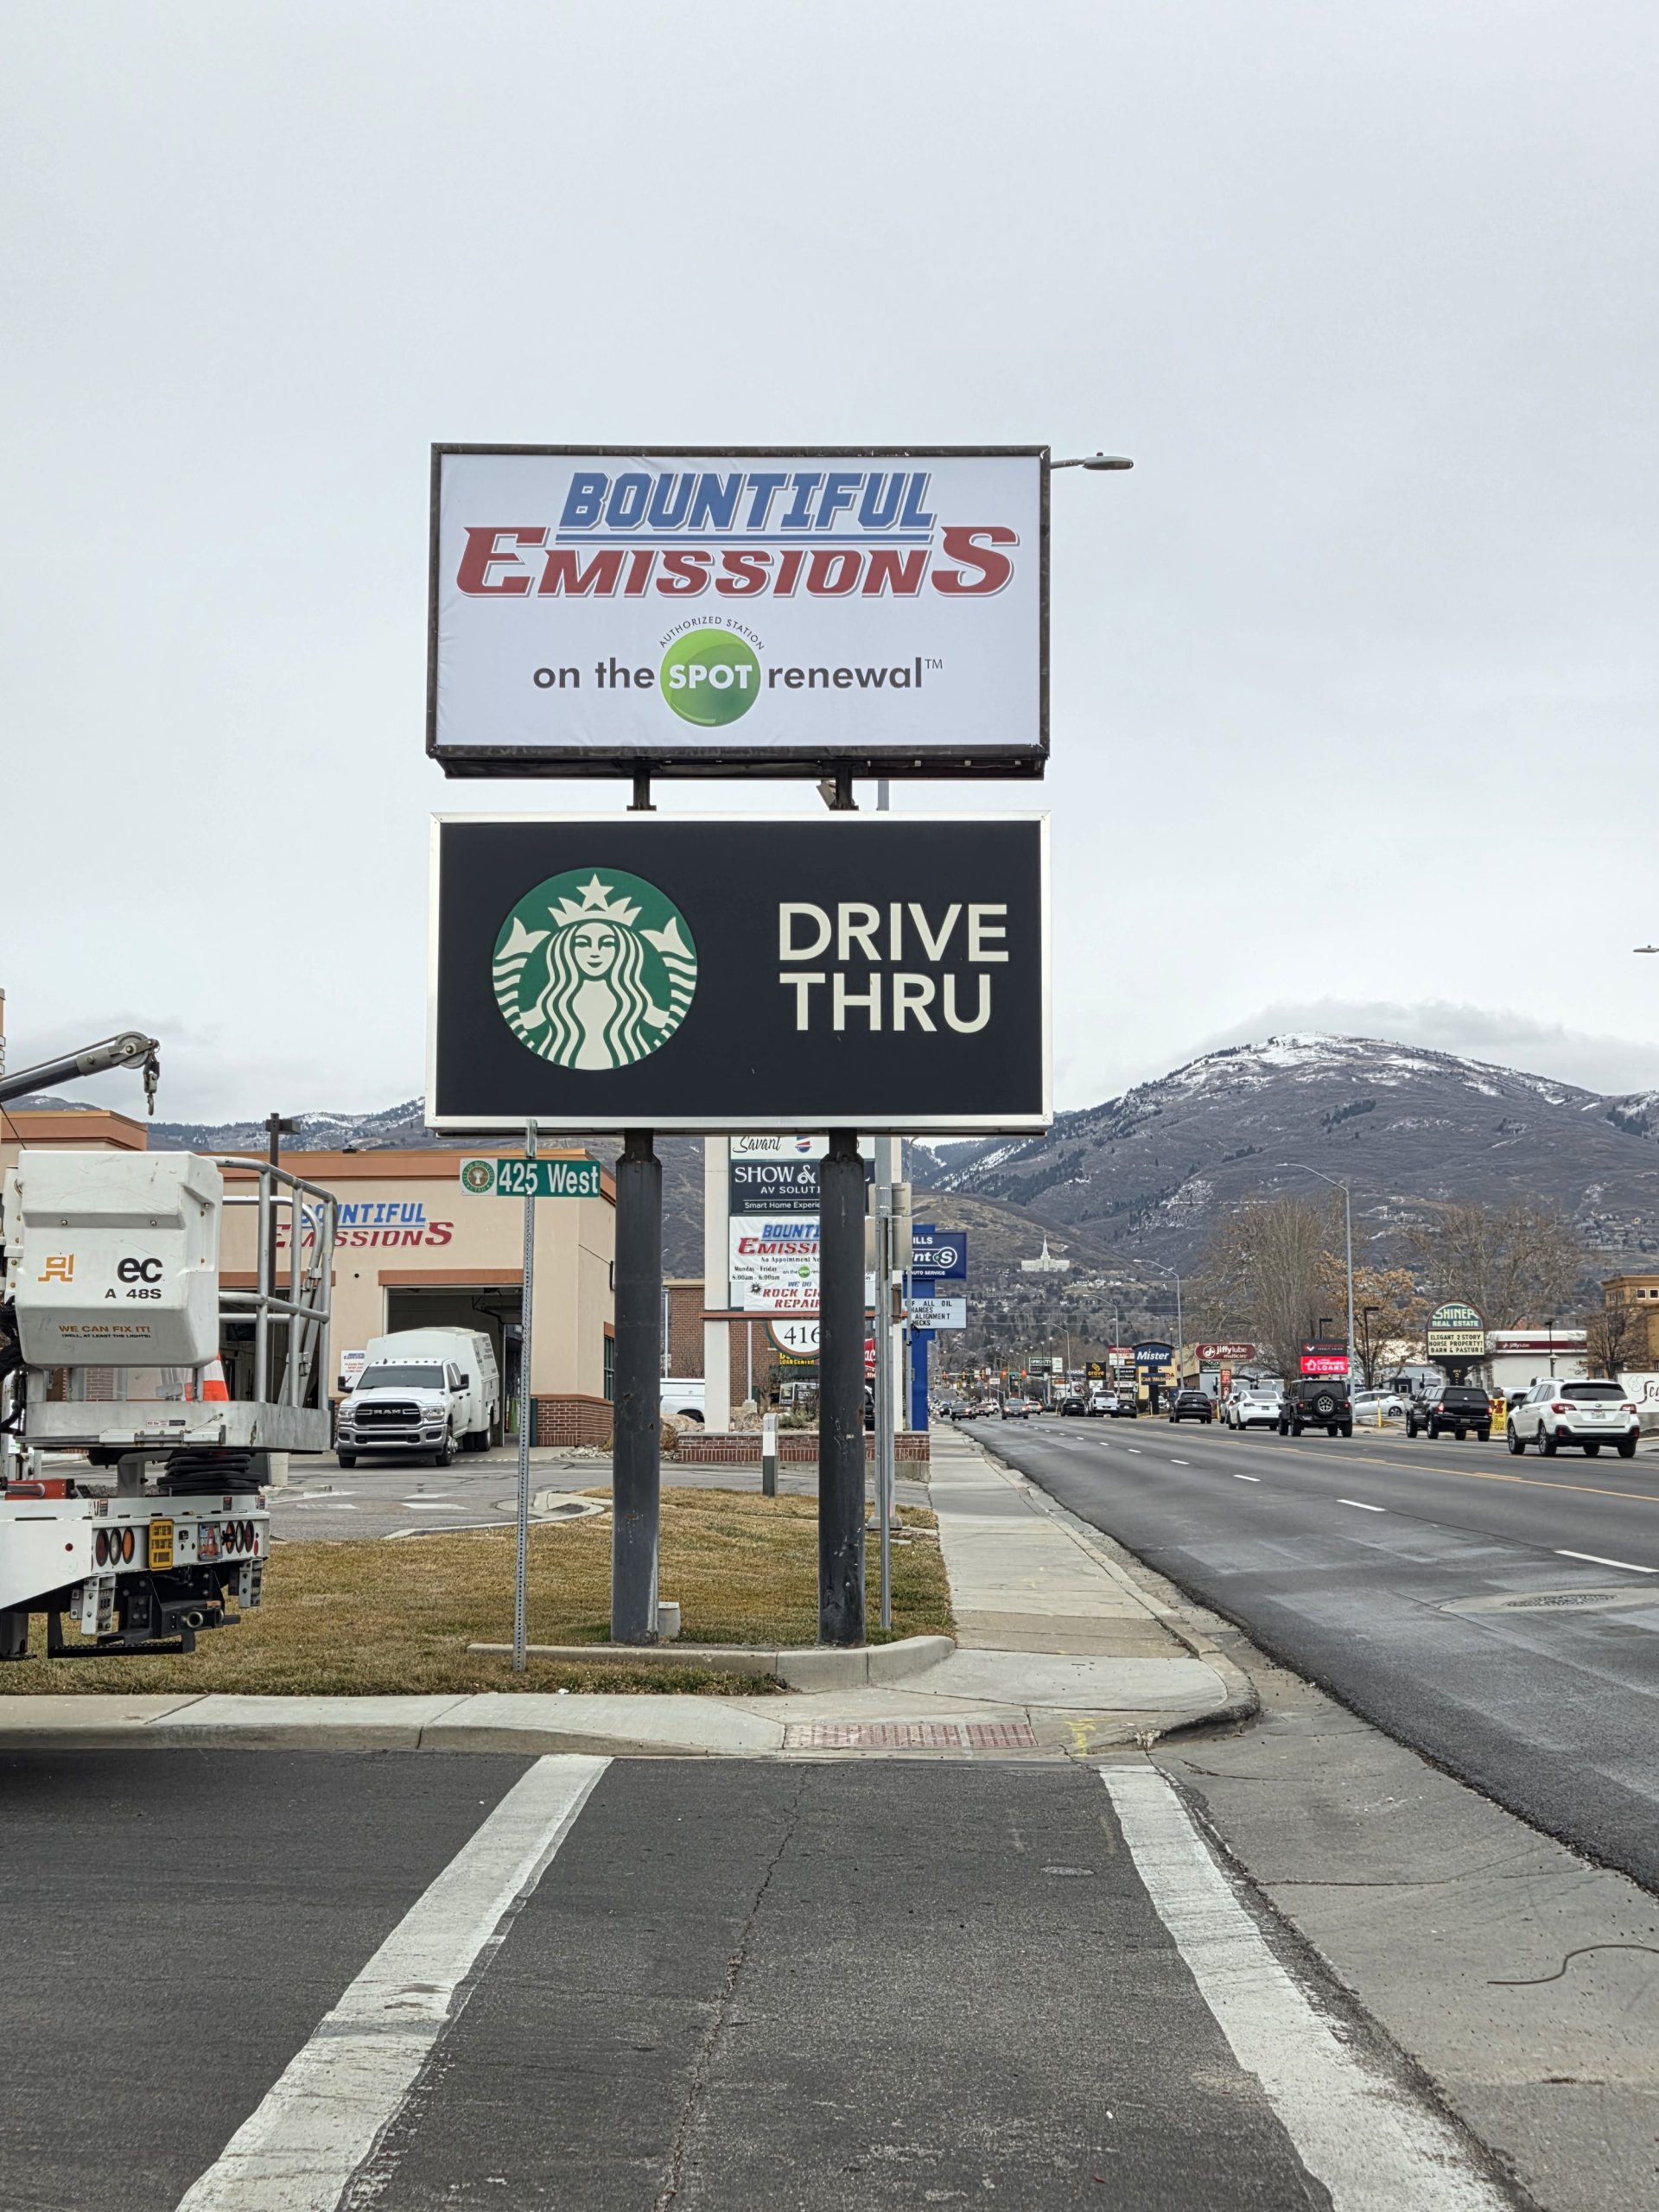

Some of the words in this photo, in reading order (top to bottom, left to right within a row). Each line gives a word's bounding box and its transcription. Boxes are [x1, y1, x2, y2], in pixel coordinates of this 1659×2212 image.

[558, 472, 938, 530] BOUNTIFUL
[455, 525, 1020, 599] EMISSIONS
[659, 616, 722, 648] AUTHORIZED
[726, 619, 765, 650] STATION
[533, 665, 580, 689] on
[595, 658, 655, 689] the
[668, 664, 753, 690] SPOT
[768, 657, 922, 689] renewal
[779, 902, 1009, 963] DRIVE
[779, 973, 992, 1033] THRU
[499, 1162, 538, 1193] 425
[547, 1164, 599, 1194] West
[734, 1166, 794, 1183] SHOW
[797, 1165, 817, 1184] &
[793, 1202, 820, 1211] Experie
[762, 1224, 820, 1238] BOUNTI
[739, 1238, 819, 1255] EMISSI
[117, 1257, 163, 1284] ec
[105, 1288, 117, 1299] A
[125, 1288, 162, 1299] 48S
[763, 1288, 798, 1298] ROCK
[1433, 1308, 1479, 1319] SHINER
[1136, 1350, 1170, 1361] Mister
